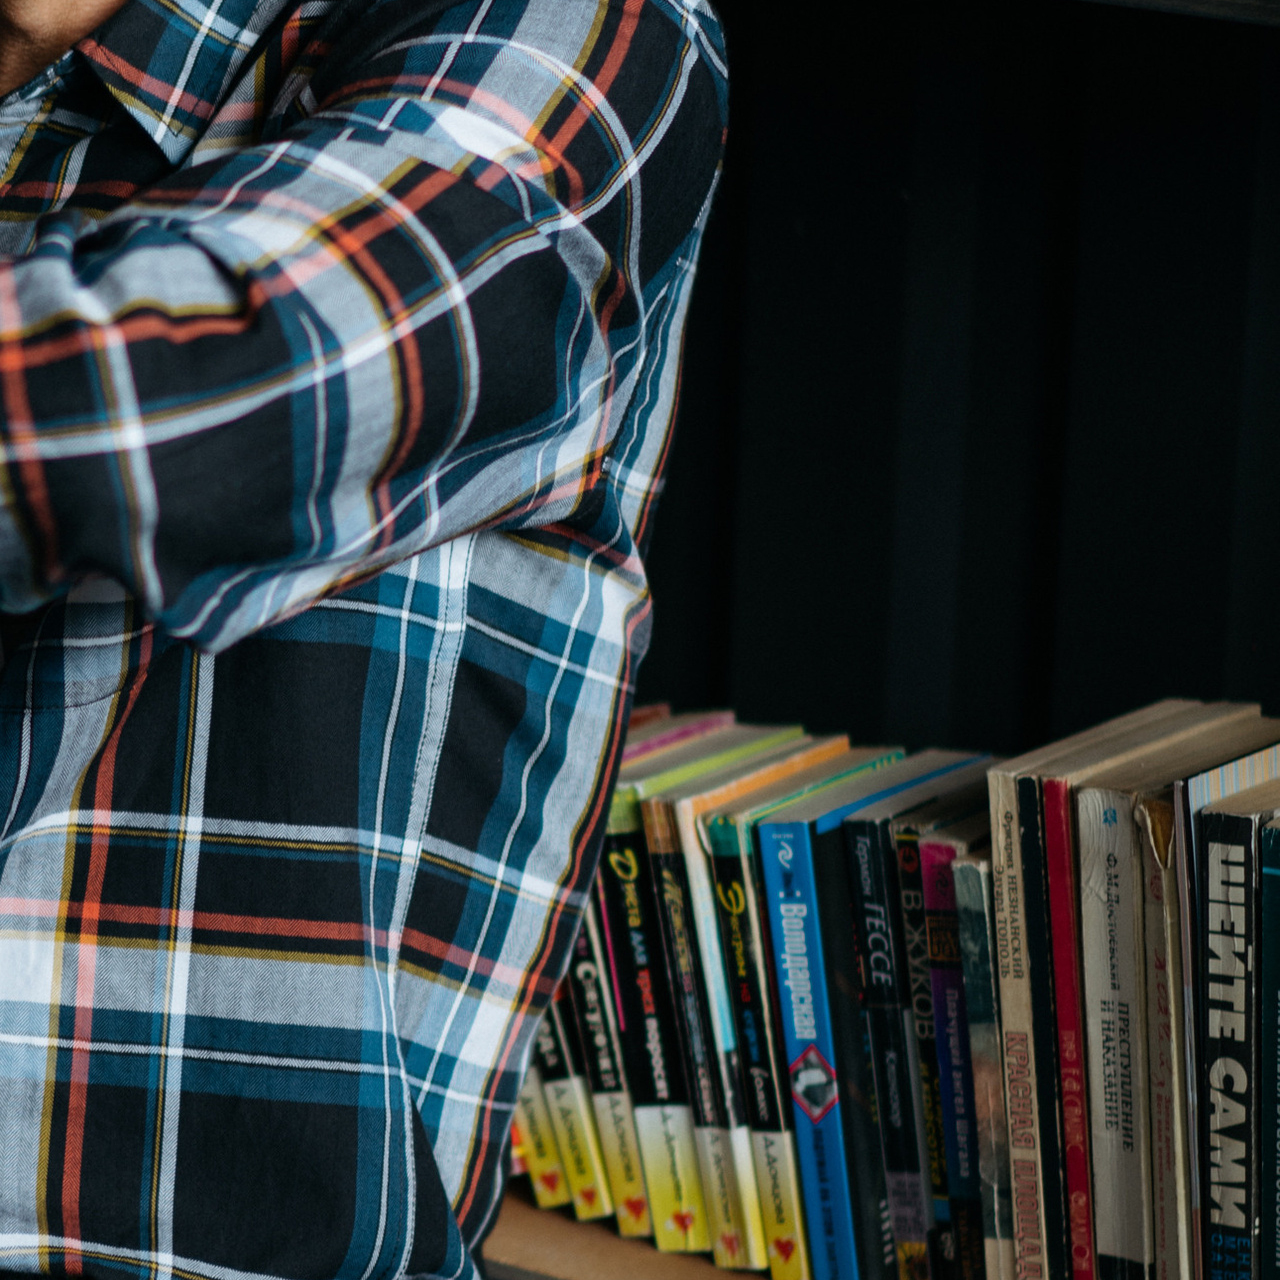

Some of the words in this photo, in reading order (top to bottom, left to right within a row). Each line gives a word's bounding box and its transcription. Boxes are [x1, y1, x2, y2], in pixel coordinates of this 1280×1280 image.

[1004, 810, 1015, 870] Фридрих
[609, 848, 641, 927] Диета
[854, 835, 871, 896] Герман
[865, 902, 893, 987] ГЕССЕ
[994, 865, 1006, 914] Эдуард
[1007, 874, 1025, 980] НЕЗНАНСКИЙ
[630, 930, 648, 966] для
[716, 881, 746, 977] Экстрим
[740, 983, 752, 1003] на
[779, 903, 817, 1040] Володарская
[998, 915, 1011, 979] ТОПОЛЬ
[1208, 841, 1253, 1042] ШЕЙТЕ
[636, 968, 656, 1016] трех
[945, 988, 961, 1067] Плачущий
[646, 1018, 669, 1100] поросят
[952, 1069, 965, 1115] ангел
[1005, 1030, 1036, 1150] КРАСНАЯ
[1101, 1019, 1120, 1132] НАКАЗАНИЕ
[1118, 1001, 1135, 1153] ПРЕСТУПЛЕНИЕ
[956, 1118, 970, 1178] Шагала
[1208, 1056, 1248, 1229] САМИ
